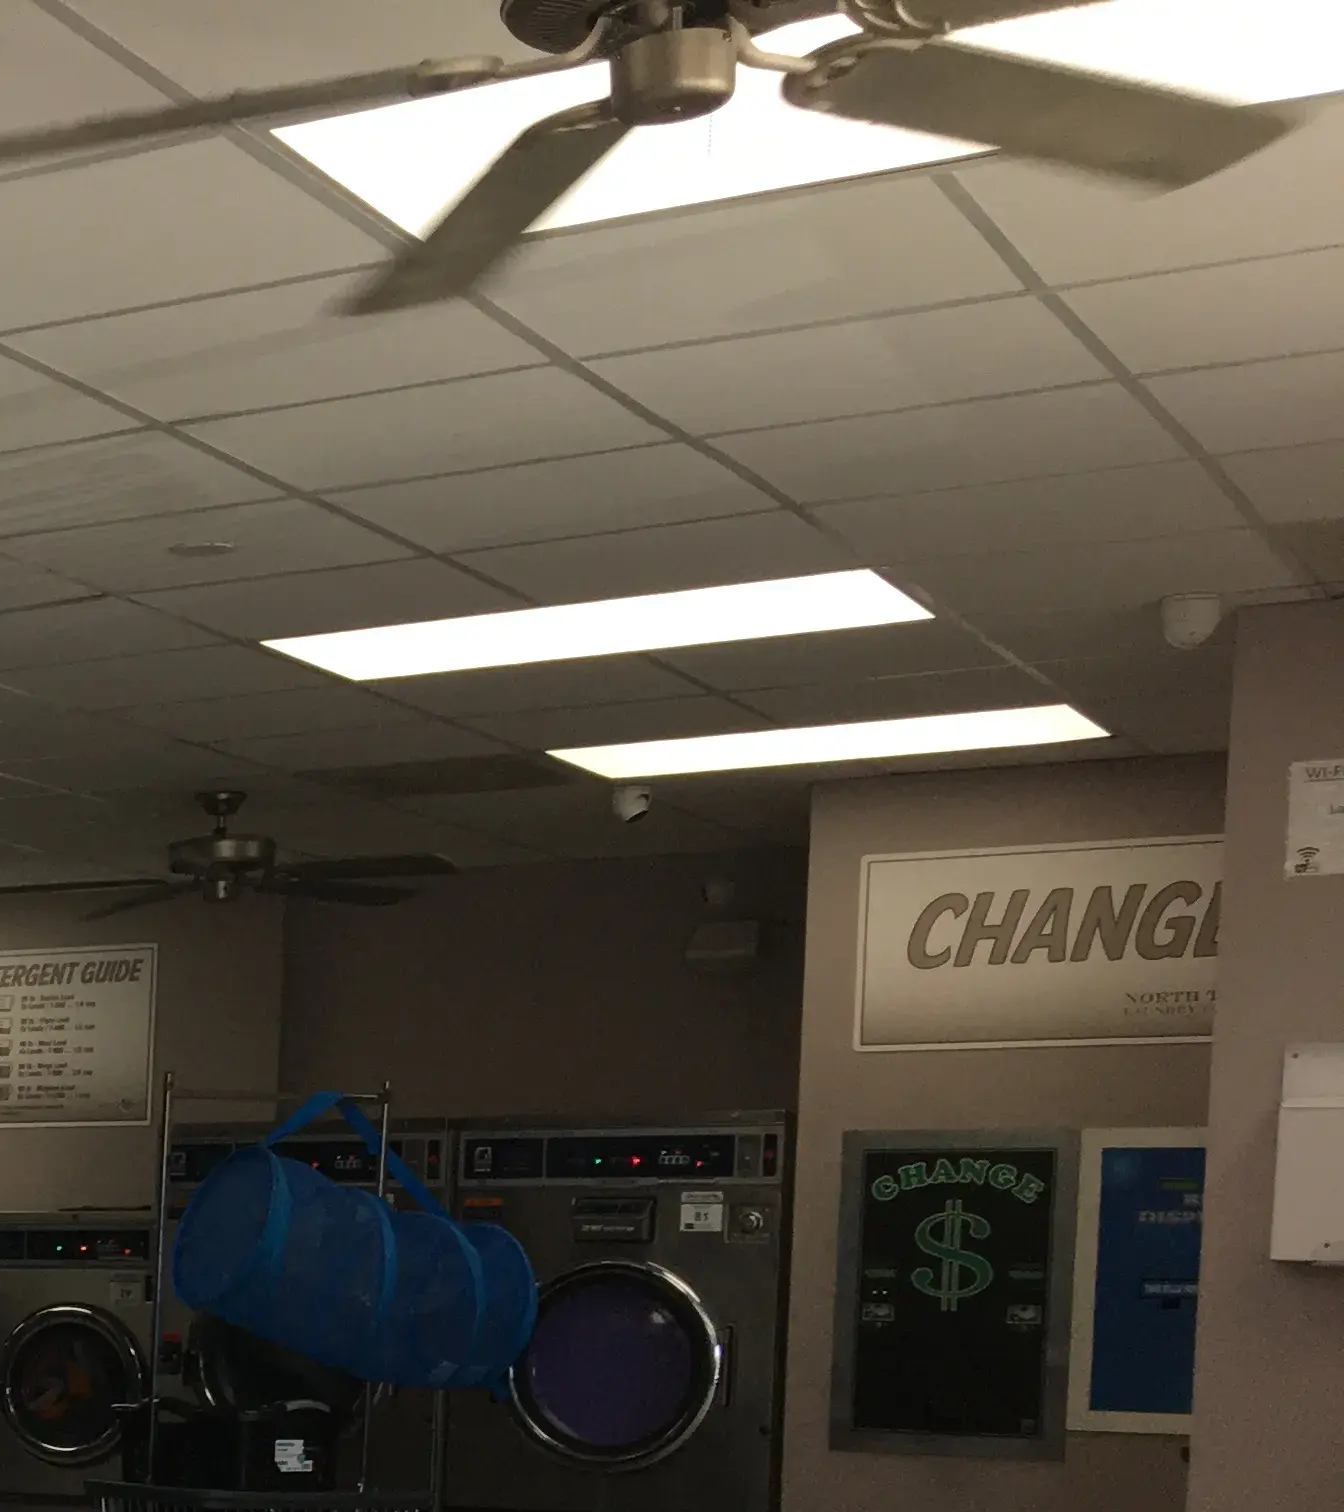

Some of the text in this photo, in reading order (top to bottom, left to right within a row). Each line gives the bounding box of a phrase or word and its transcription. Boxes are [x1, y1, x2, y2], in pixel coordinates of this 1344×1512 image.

[81, 958, 145, 984] GUIDE
[1124, 989, 1200, 1004] NORTH
[871, 1157, 1045, 1204] CHANGE
